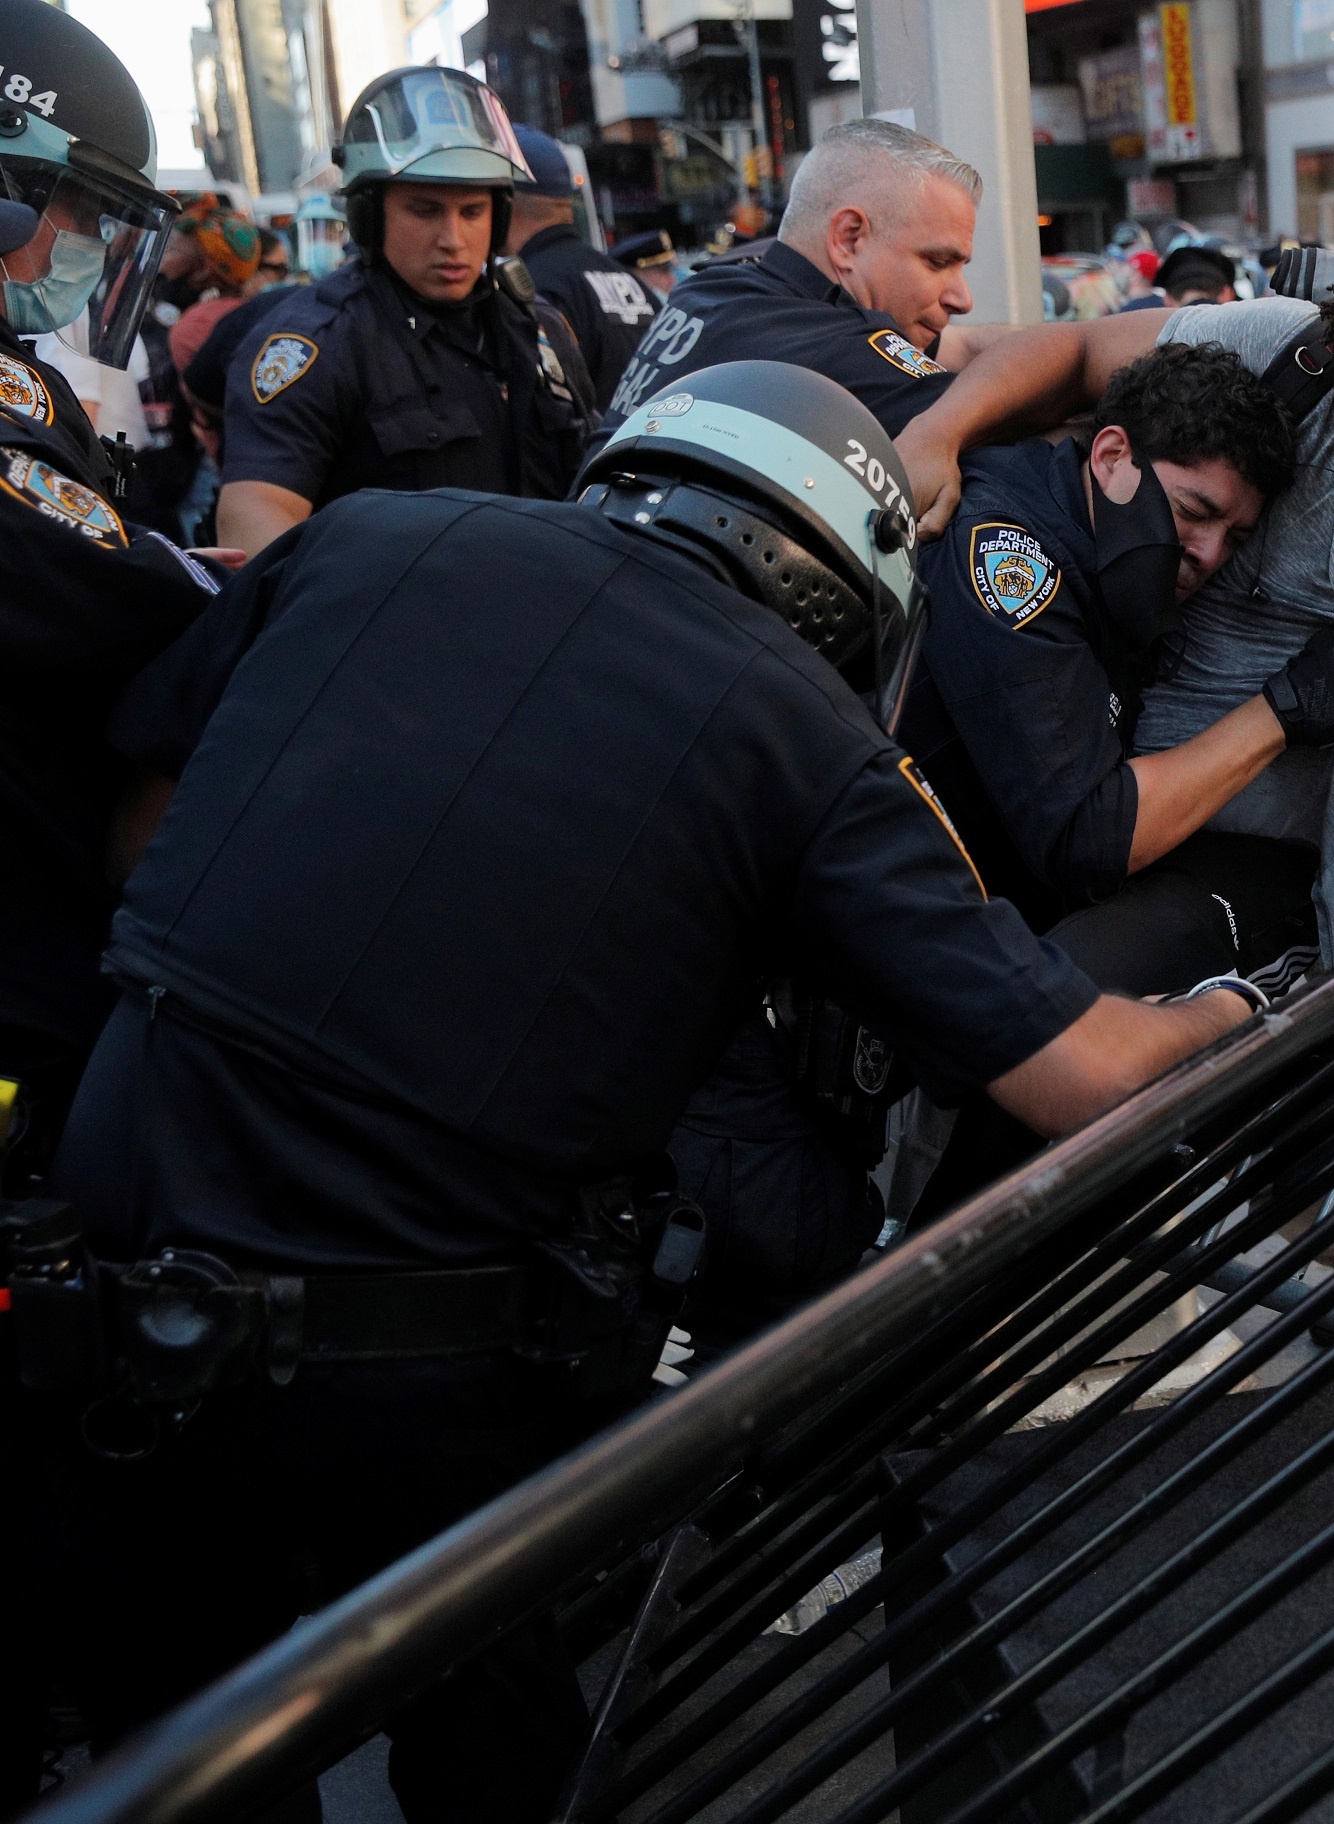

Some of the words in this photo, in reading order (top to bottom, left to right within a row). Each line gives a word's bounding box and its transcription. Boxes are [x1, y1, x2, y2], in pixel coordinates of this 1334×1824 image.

[637, 303, 705, 366] YPD
[653, 401, 688, 412] DOT
[38, 502, 78, 529] CITY
[80, 525, 104, 539] OF
[998, 530, 1041, 551] POLICE
[979, 541, 1054, 570] DEPARTMENT
[975, 566, 990, 593] CITY
[986, 595, 999, 611] OF
[1016, 599, 1039, 620] NEW
[1036, 576, 1055, 601] YORK
[1211, 893, 1237, 936] adidas
